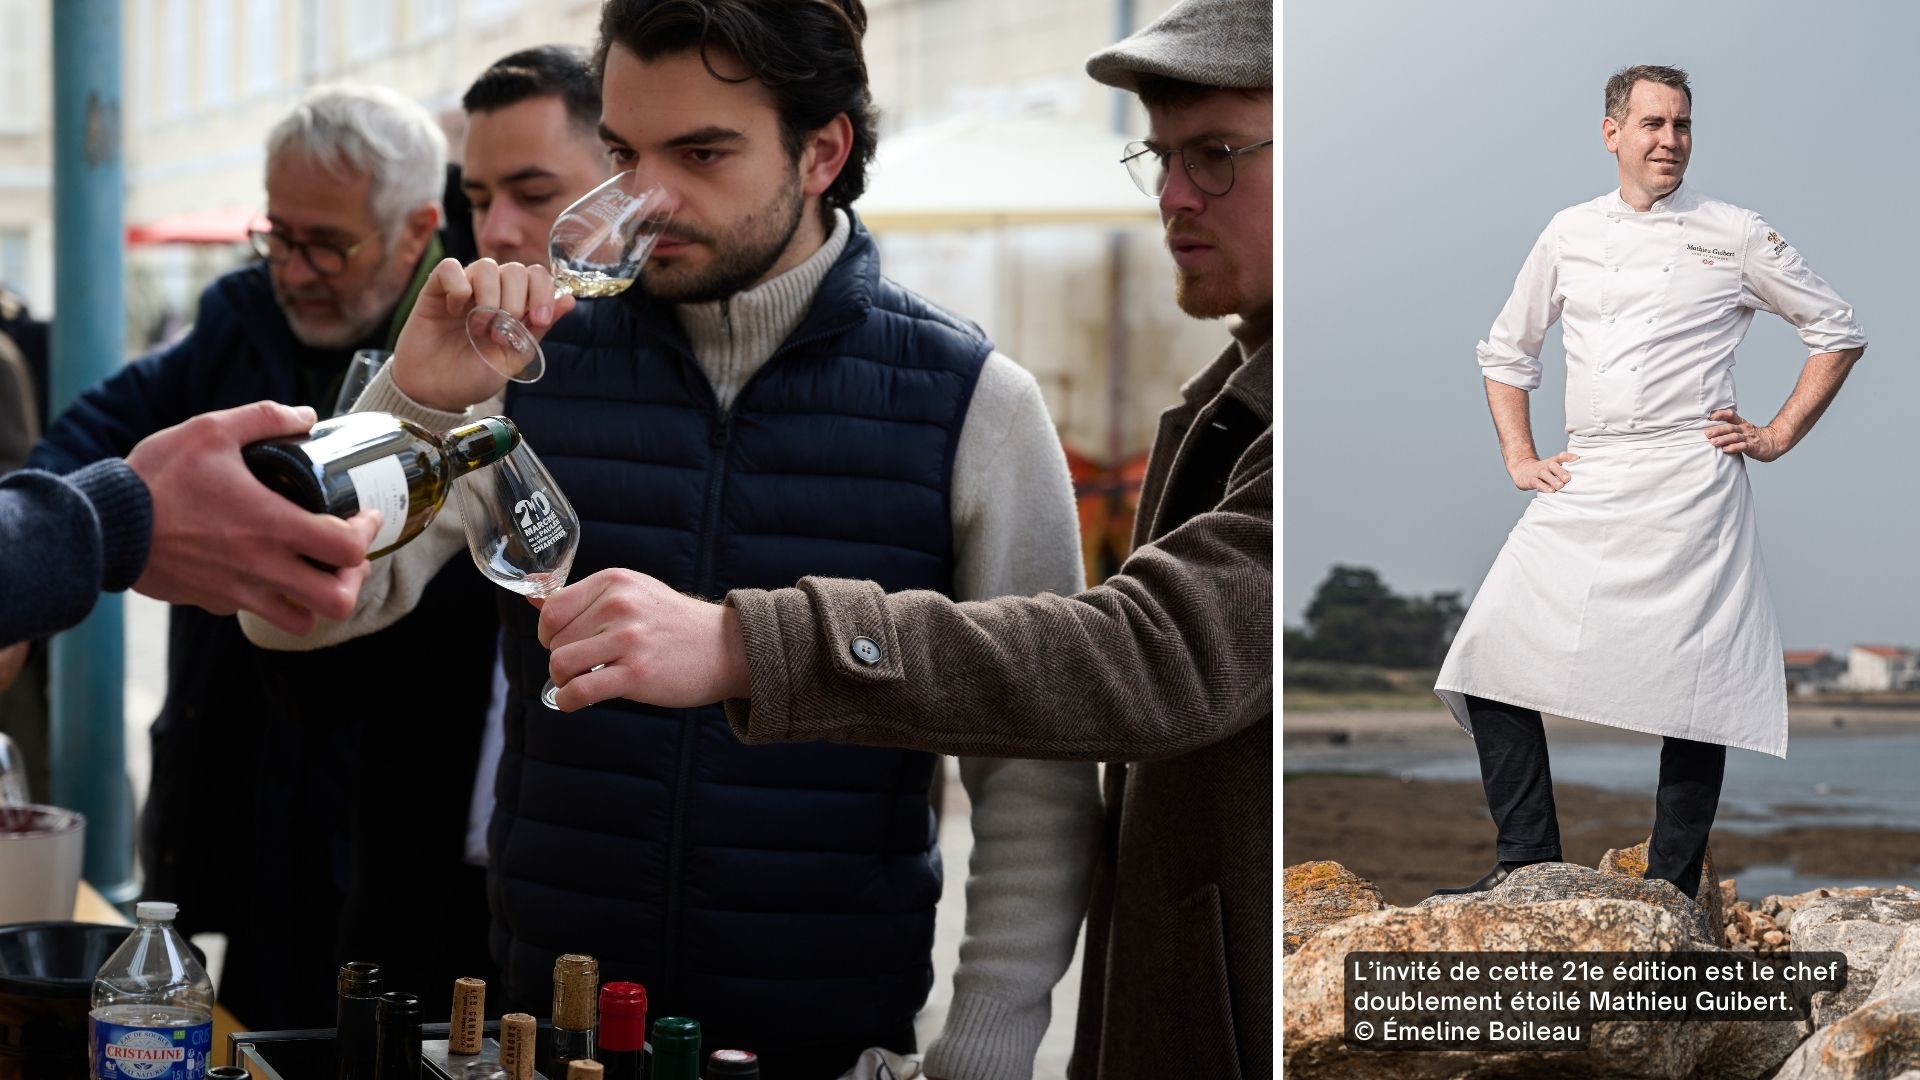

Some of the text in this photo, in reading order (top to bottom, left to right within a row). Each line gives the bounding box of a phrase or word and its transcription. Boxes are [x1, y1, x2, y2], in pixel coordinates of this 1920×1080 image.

[514, 491, 551, 529] 20
[524, 510, 557, 537] MARCHÉ
[533, 528, 567, 554] CHARTRES
[120, 1034, 132, 1044] EAU
[145, 1032, 169, 1045] SOURCE
[107, 1045, 183, 1060] CRISTALINE
